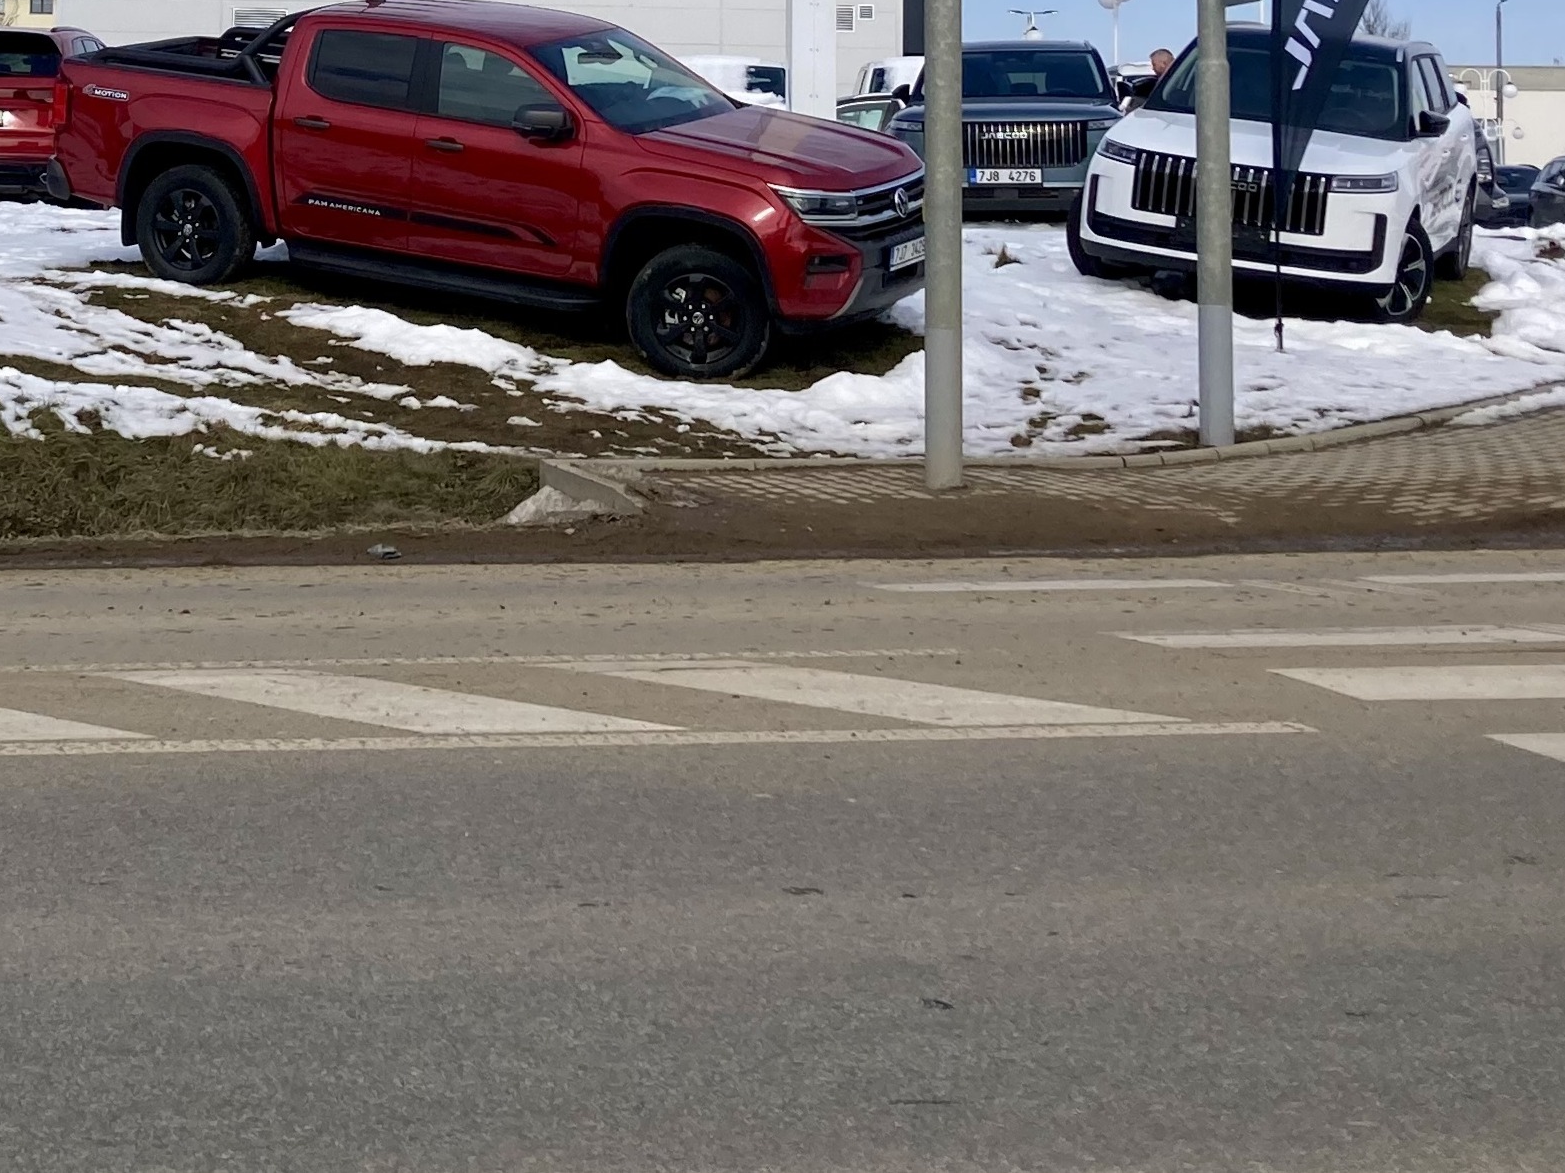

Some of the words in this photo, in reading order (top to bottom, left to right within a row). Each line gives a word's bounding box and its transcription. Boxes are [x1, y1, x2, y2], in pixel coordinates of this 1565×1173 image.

[979, 171, 1000, 182] 7J8
[1008, 171, 1036, 182] 4276
[329, 202, 381, 216] AMERICANA
